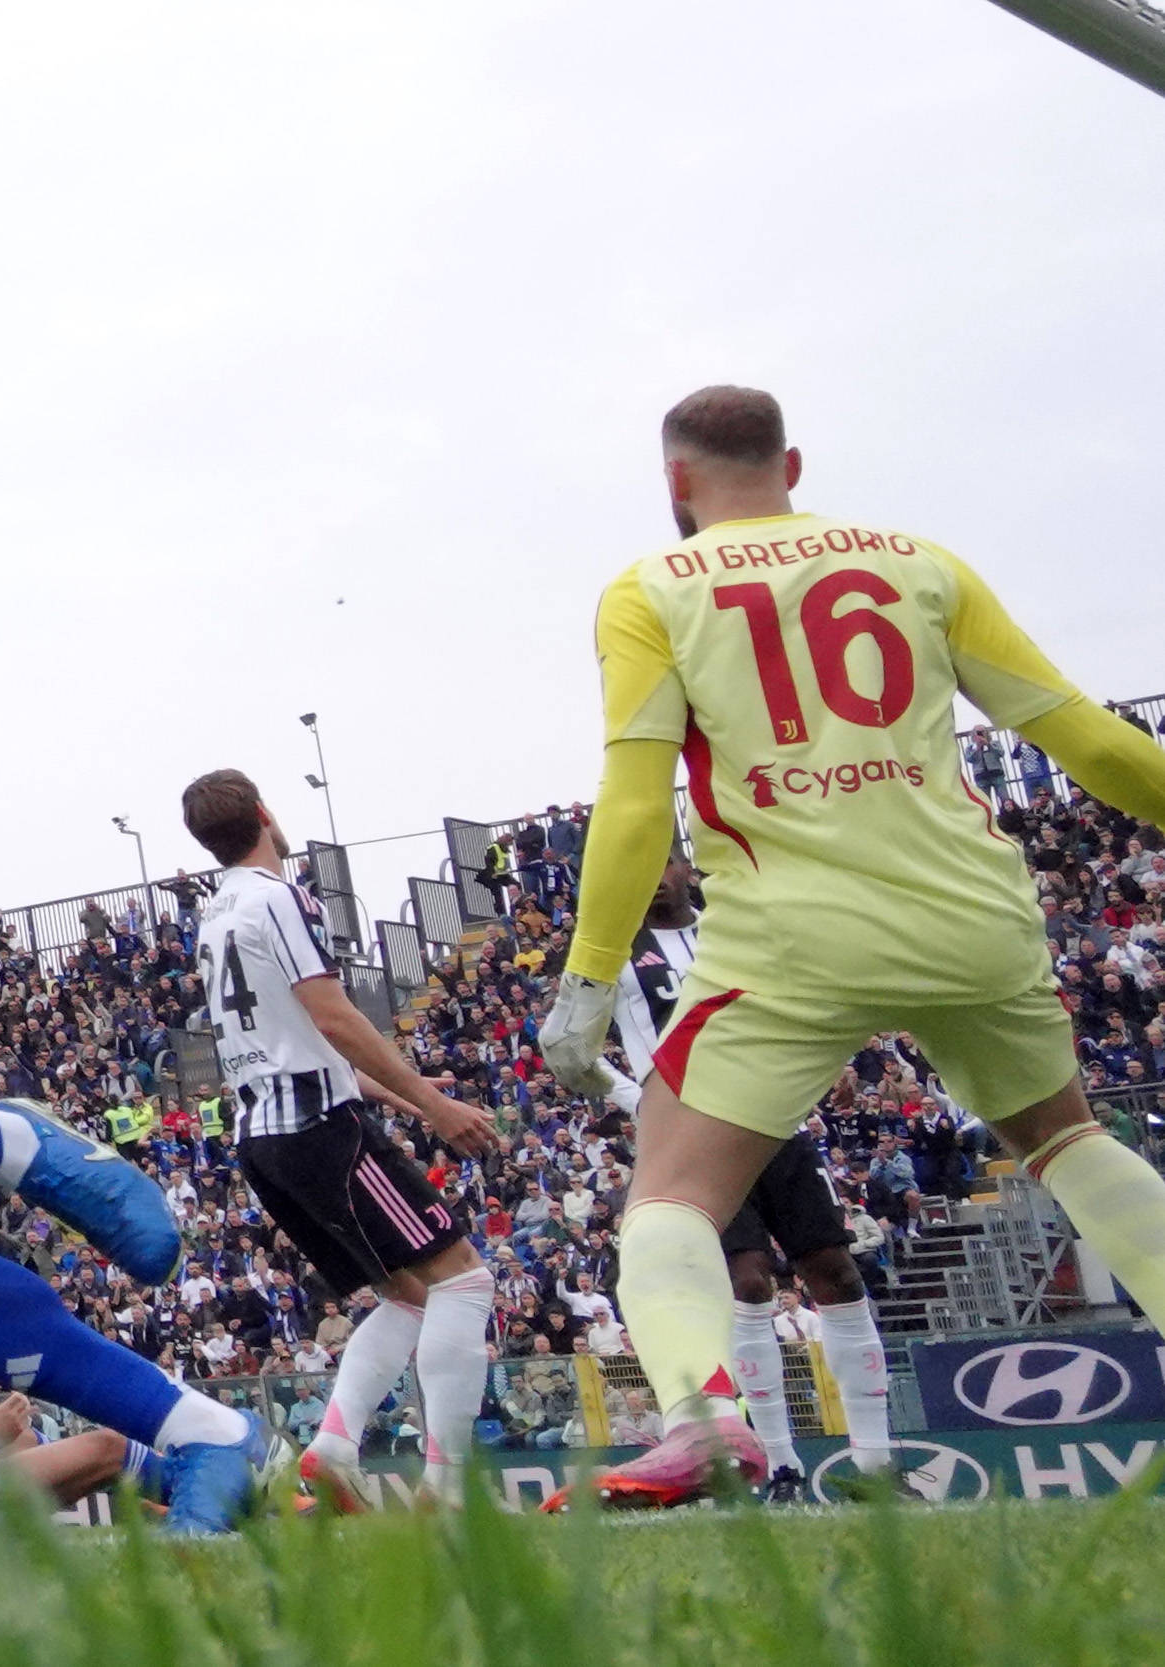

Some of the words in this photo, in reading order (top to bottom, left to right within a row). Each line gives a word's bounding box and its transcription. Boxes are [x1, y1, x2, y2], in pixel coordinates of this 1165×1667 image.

[665, 551, 707, 579] DI
[717, 528, 916, 570] GREGORIO
[713, 568, 914, 746] 16
